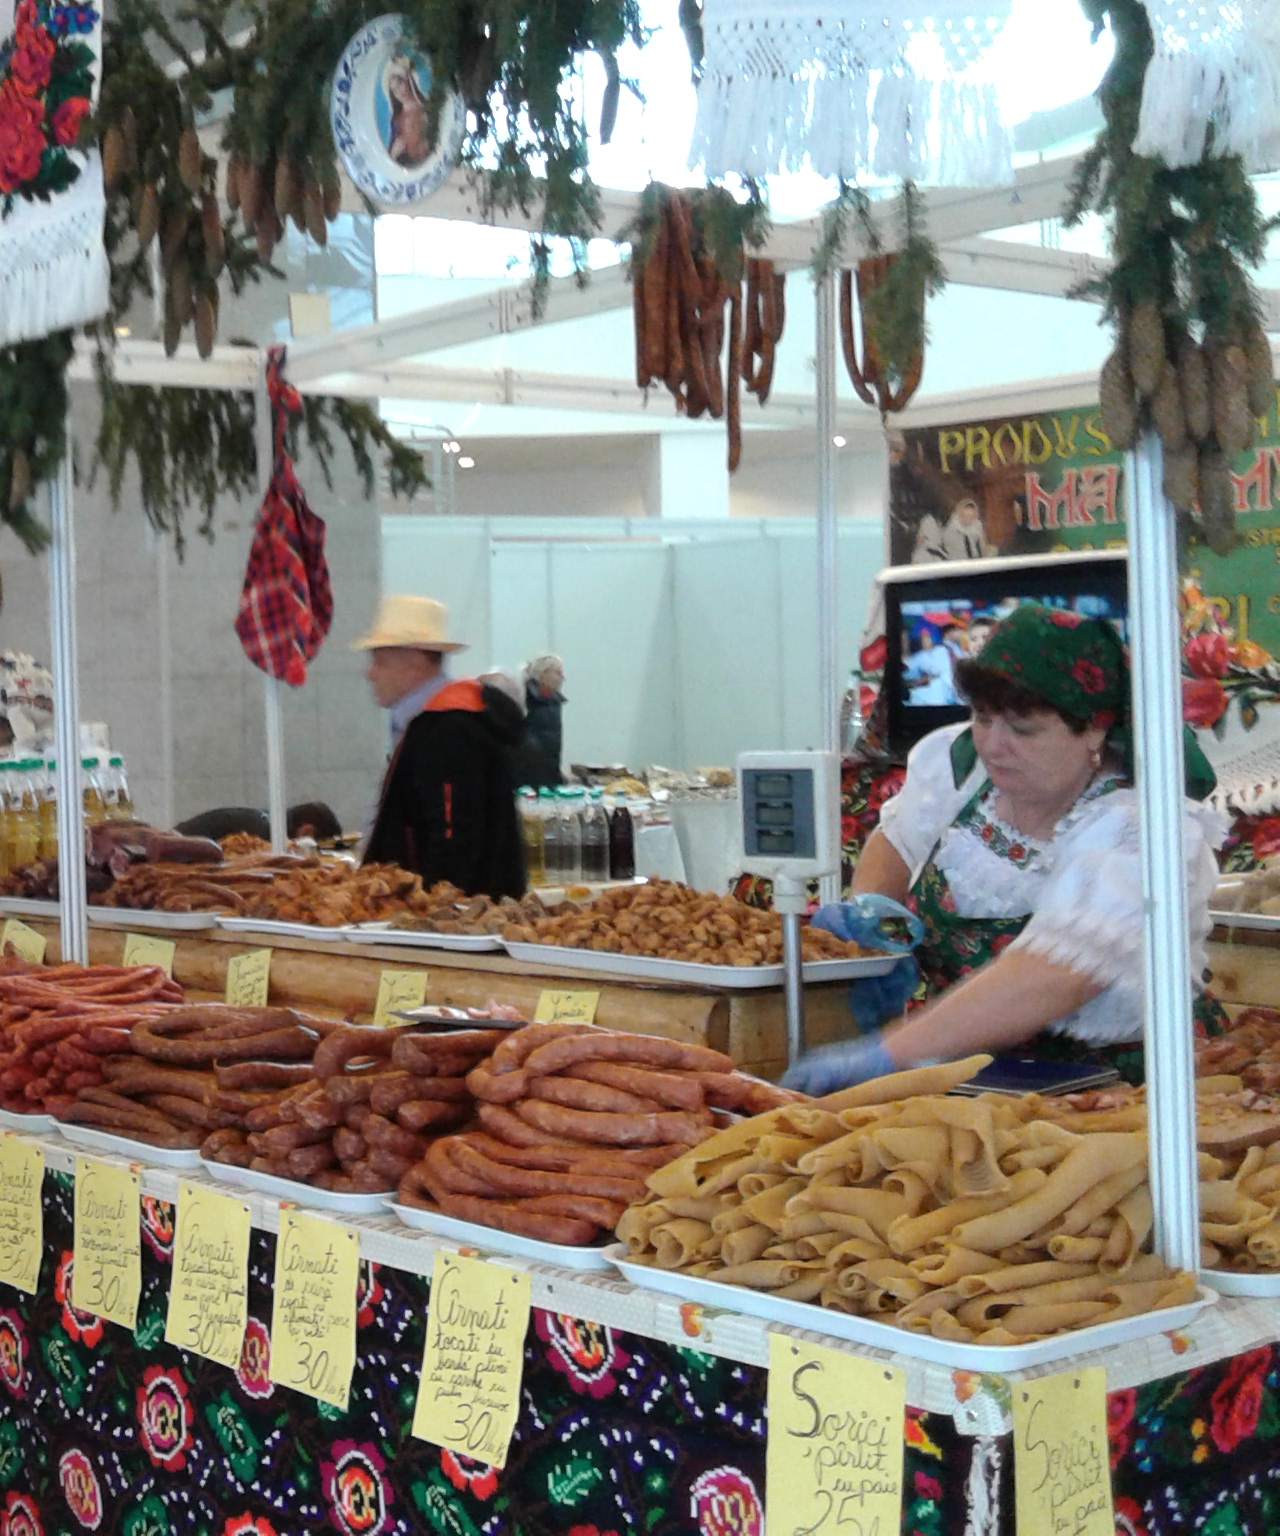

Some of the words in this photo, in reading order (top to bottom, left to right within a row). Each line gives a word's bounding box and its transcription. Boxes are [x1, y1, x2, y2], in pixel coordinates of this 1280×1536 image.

[86, 1270, 120, 1313] 30
[182, 1313, 216, 1355] 30
[290, 1341, 330, 1391] 30
[443, 1403, 493, 1452] 30
[792, 1489, 863, 1536] 25
